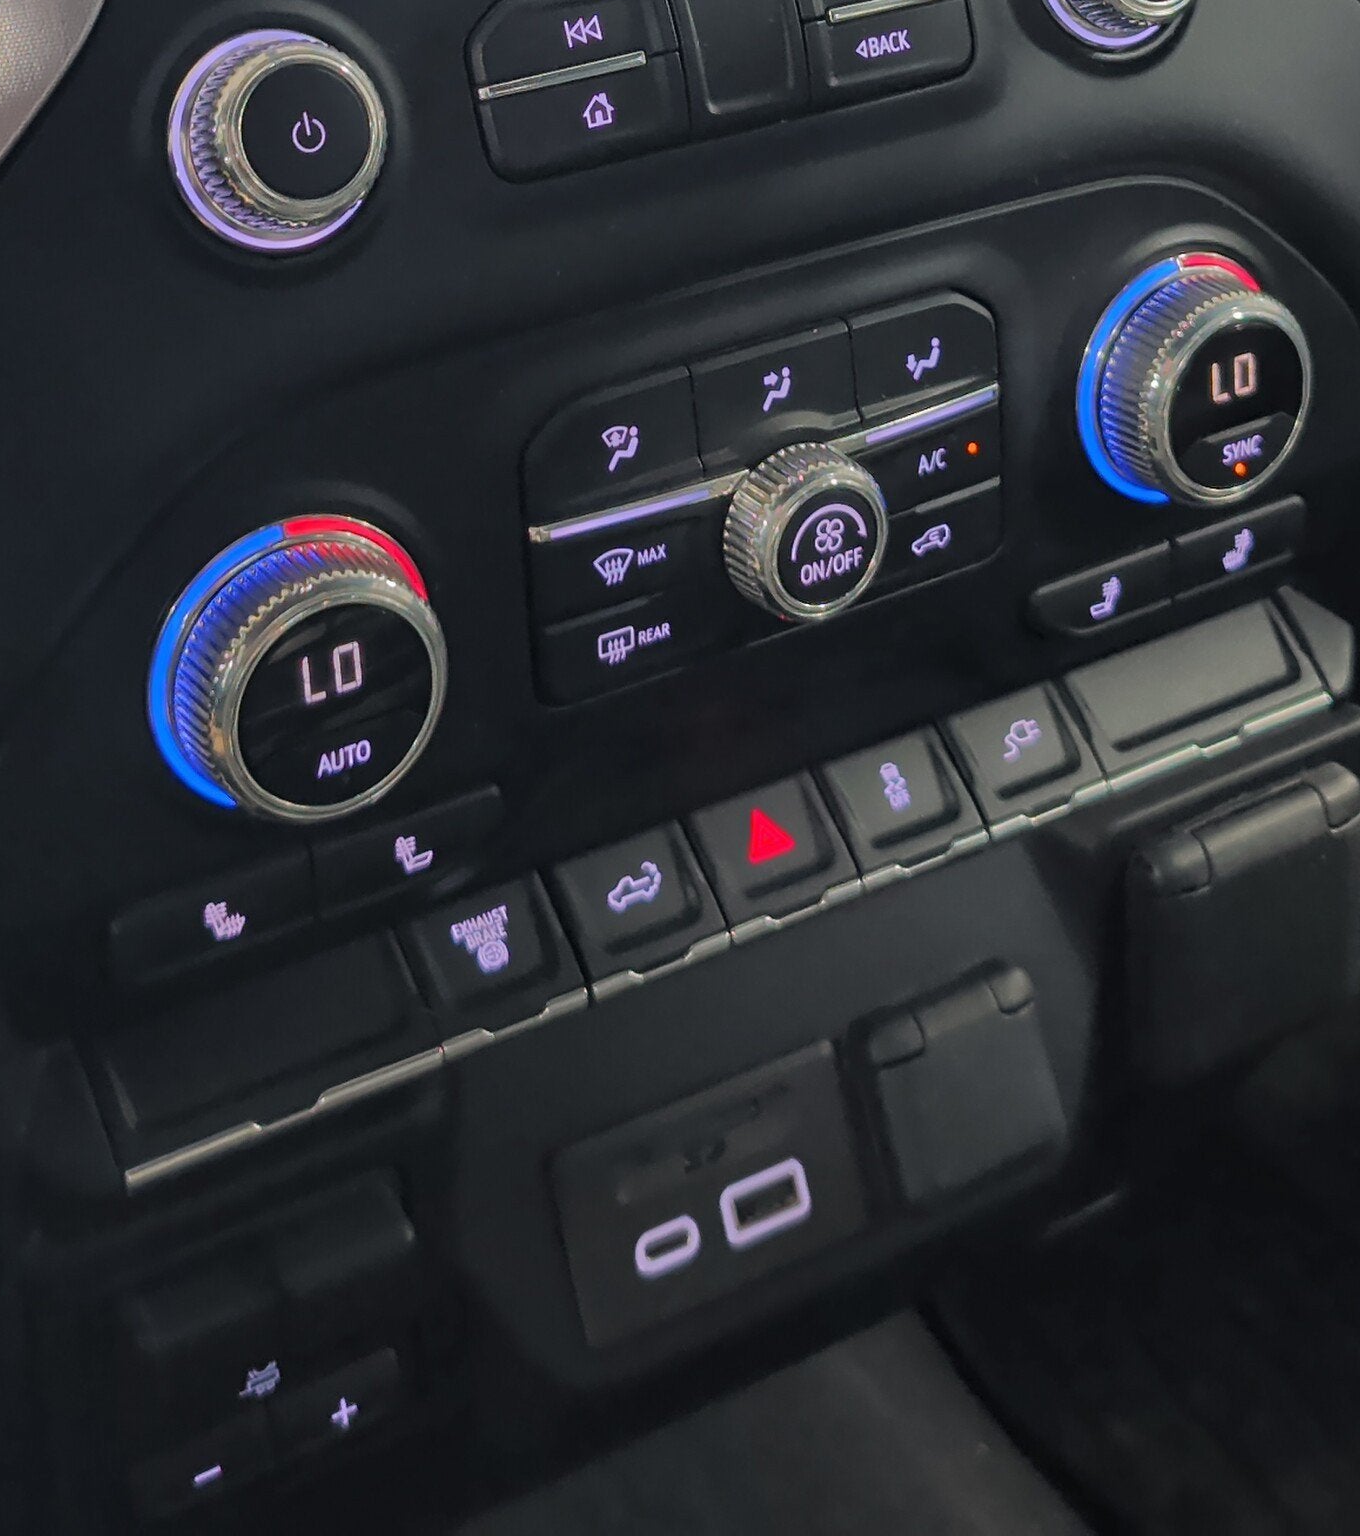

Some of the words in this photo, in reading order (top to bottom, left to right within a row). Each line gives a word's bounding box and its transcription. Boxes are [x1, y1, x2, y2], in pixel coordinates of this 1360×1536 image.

[869, 30, 910, 58] BACK
[918, 448, 947, 477] A/C
[1223, 434, 1264, 466] SYNC
[638, 544, 667, 566] MAX
[800, 547, 864, 586] ON/OFF
[638, 623, 671, 645] REAR
[317, 739, 371, 778] AUTO
[451, 905, 508, 945] EXHAUST
[466, 927, 507, 953] BRAKE
